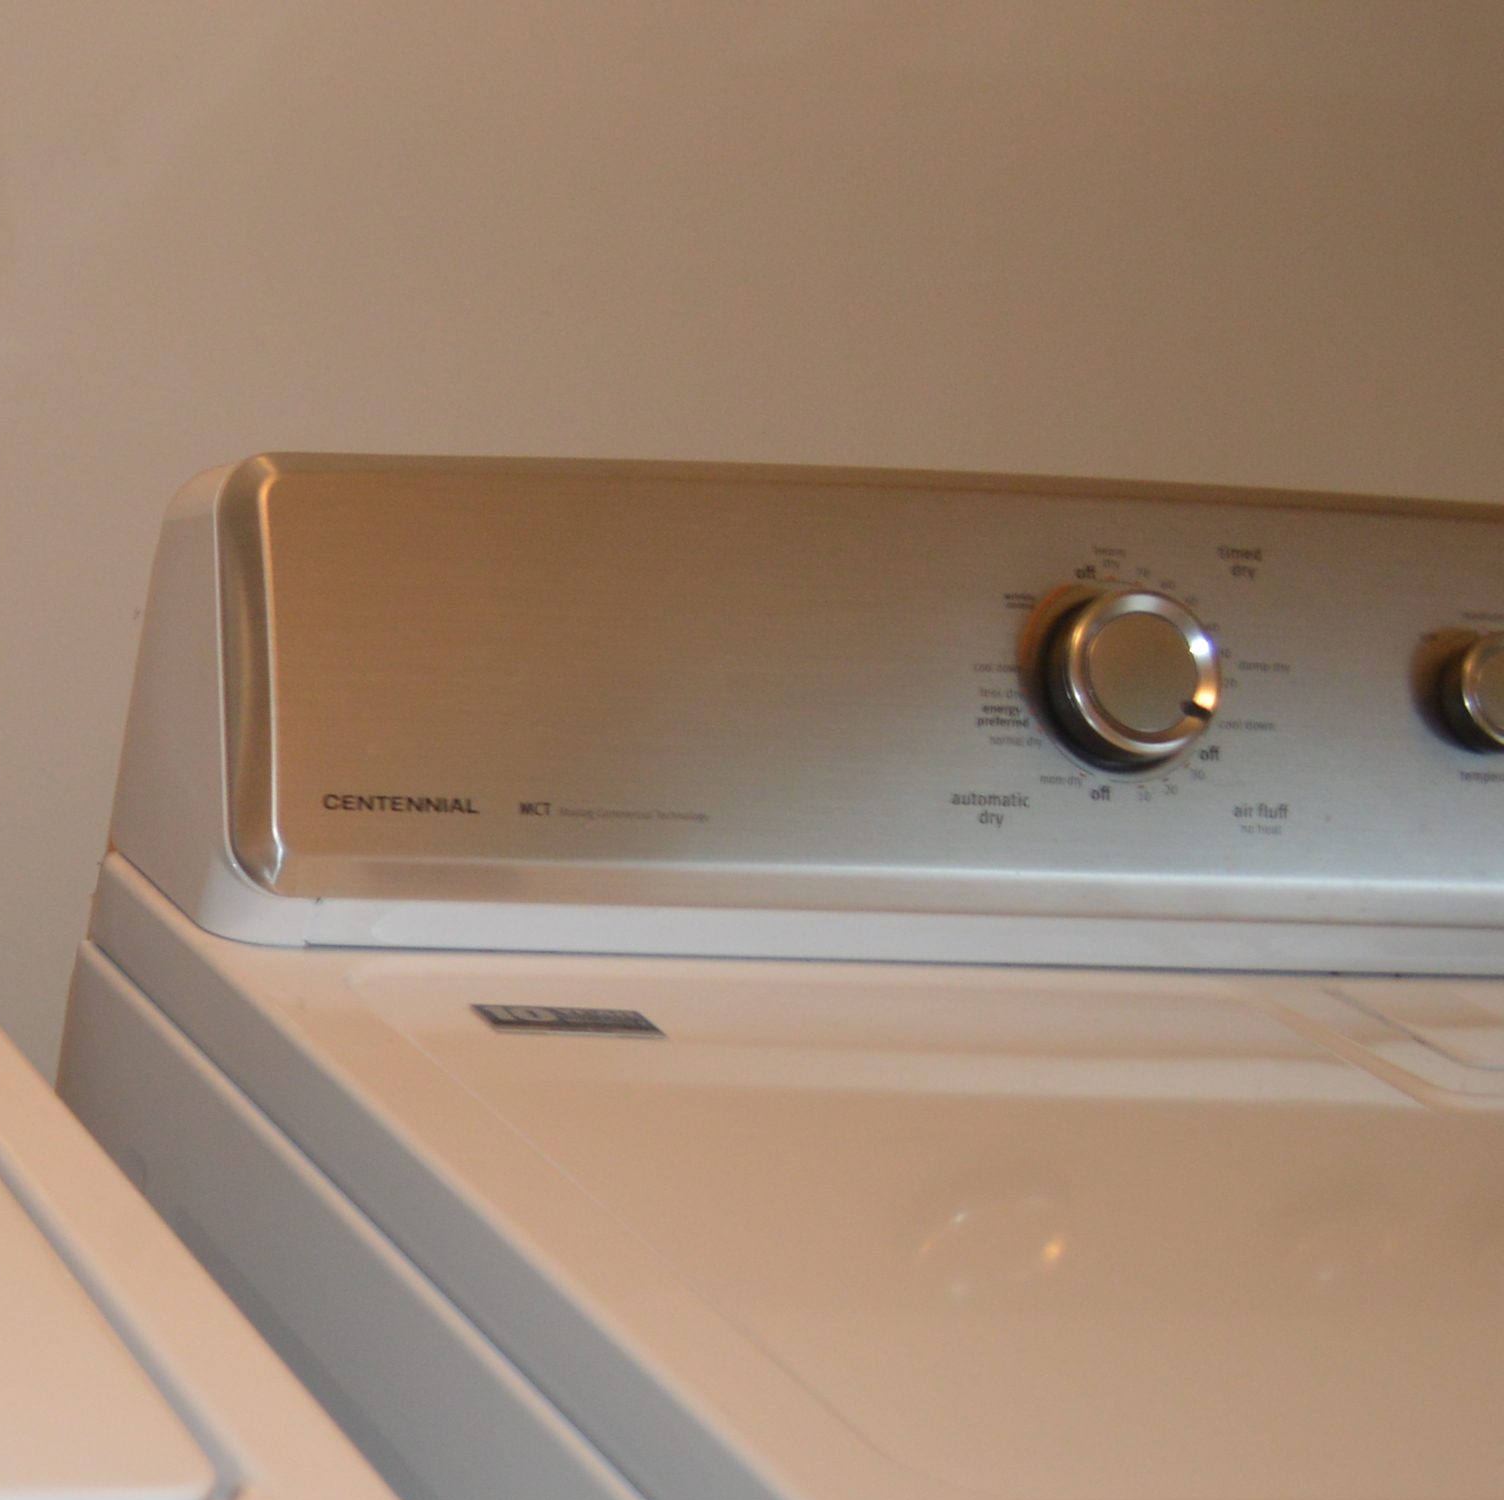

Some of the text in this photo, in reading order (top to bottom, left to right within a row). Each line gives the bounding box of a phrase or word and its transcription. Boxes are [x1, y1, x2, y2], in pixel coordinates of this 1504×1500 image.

[1218, 547, 1263, 561] timed
[1075, 565, 1096, 580] off
[1231, 563, 1256, 581] dry
[982, 704, 1023, 718] energy
[977, 715, 1030, 728] preferred
[1245, 719, 1276, 731] down
[1199, 745, 1220, 761] off
[950, 791, 1030, 809] automatic
[1090, 785, 1111, 801] off
[322, 794, 480, 816] CENTENNIAL
[519, 802, 551, 818] MCT
[1232, 802, 1289, 819] air fluff
[978, 810, 1005, 828] dry
